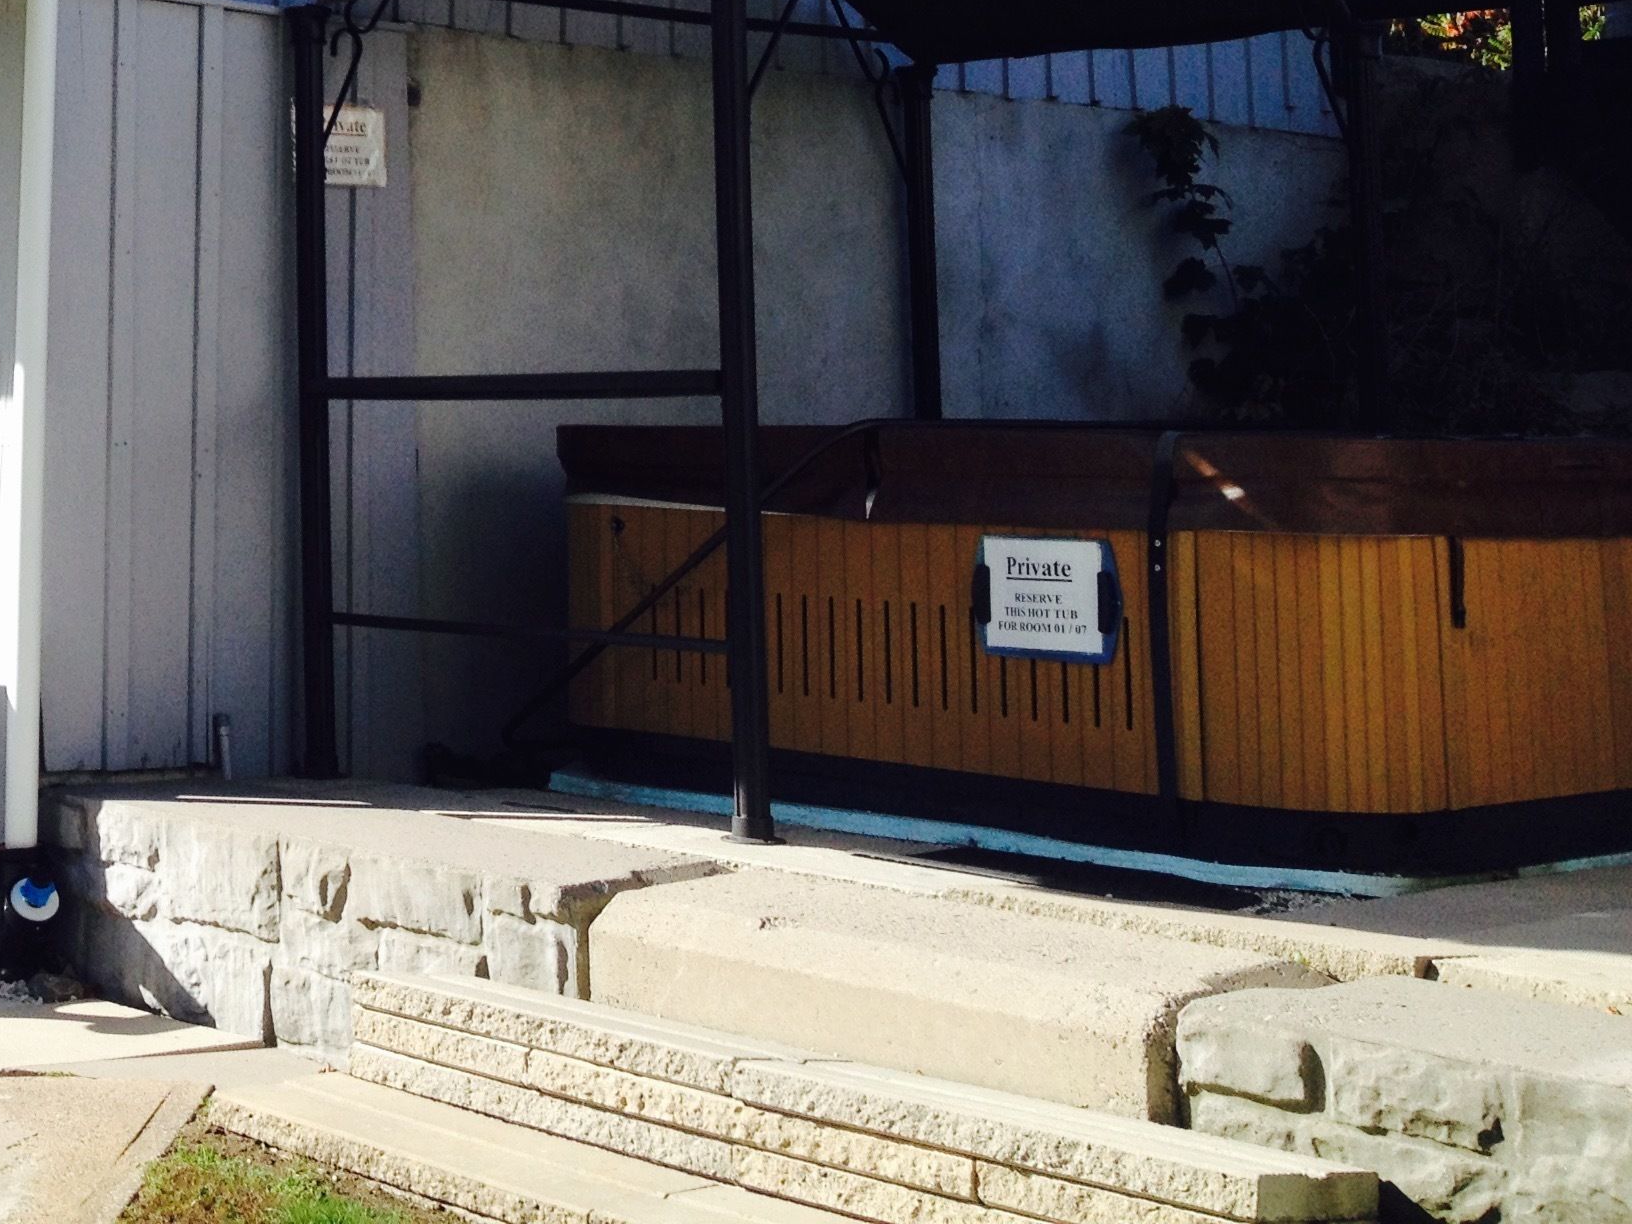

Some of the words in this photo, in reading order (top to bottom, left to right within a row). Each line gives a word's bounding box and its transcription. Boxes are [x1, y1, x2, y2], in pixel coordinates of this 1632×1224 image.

[1006, 556, 1072, 577] Private
[1014, 592, 1063, 605] RESERVE
[1004, 606, 1026, 617] THIS
[1028, 608, 1050, 618] HOT
[1053, 609, 1078, 620] TUB
[998, 620, 1018, 631] FOR
[1019, 622, 1052, 633] ROOM
[1054, 623, 1065, 634] 01
[1075, 624, 1087, 635] 07
